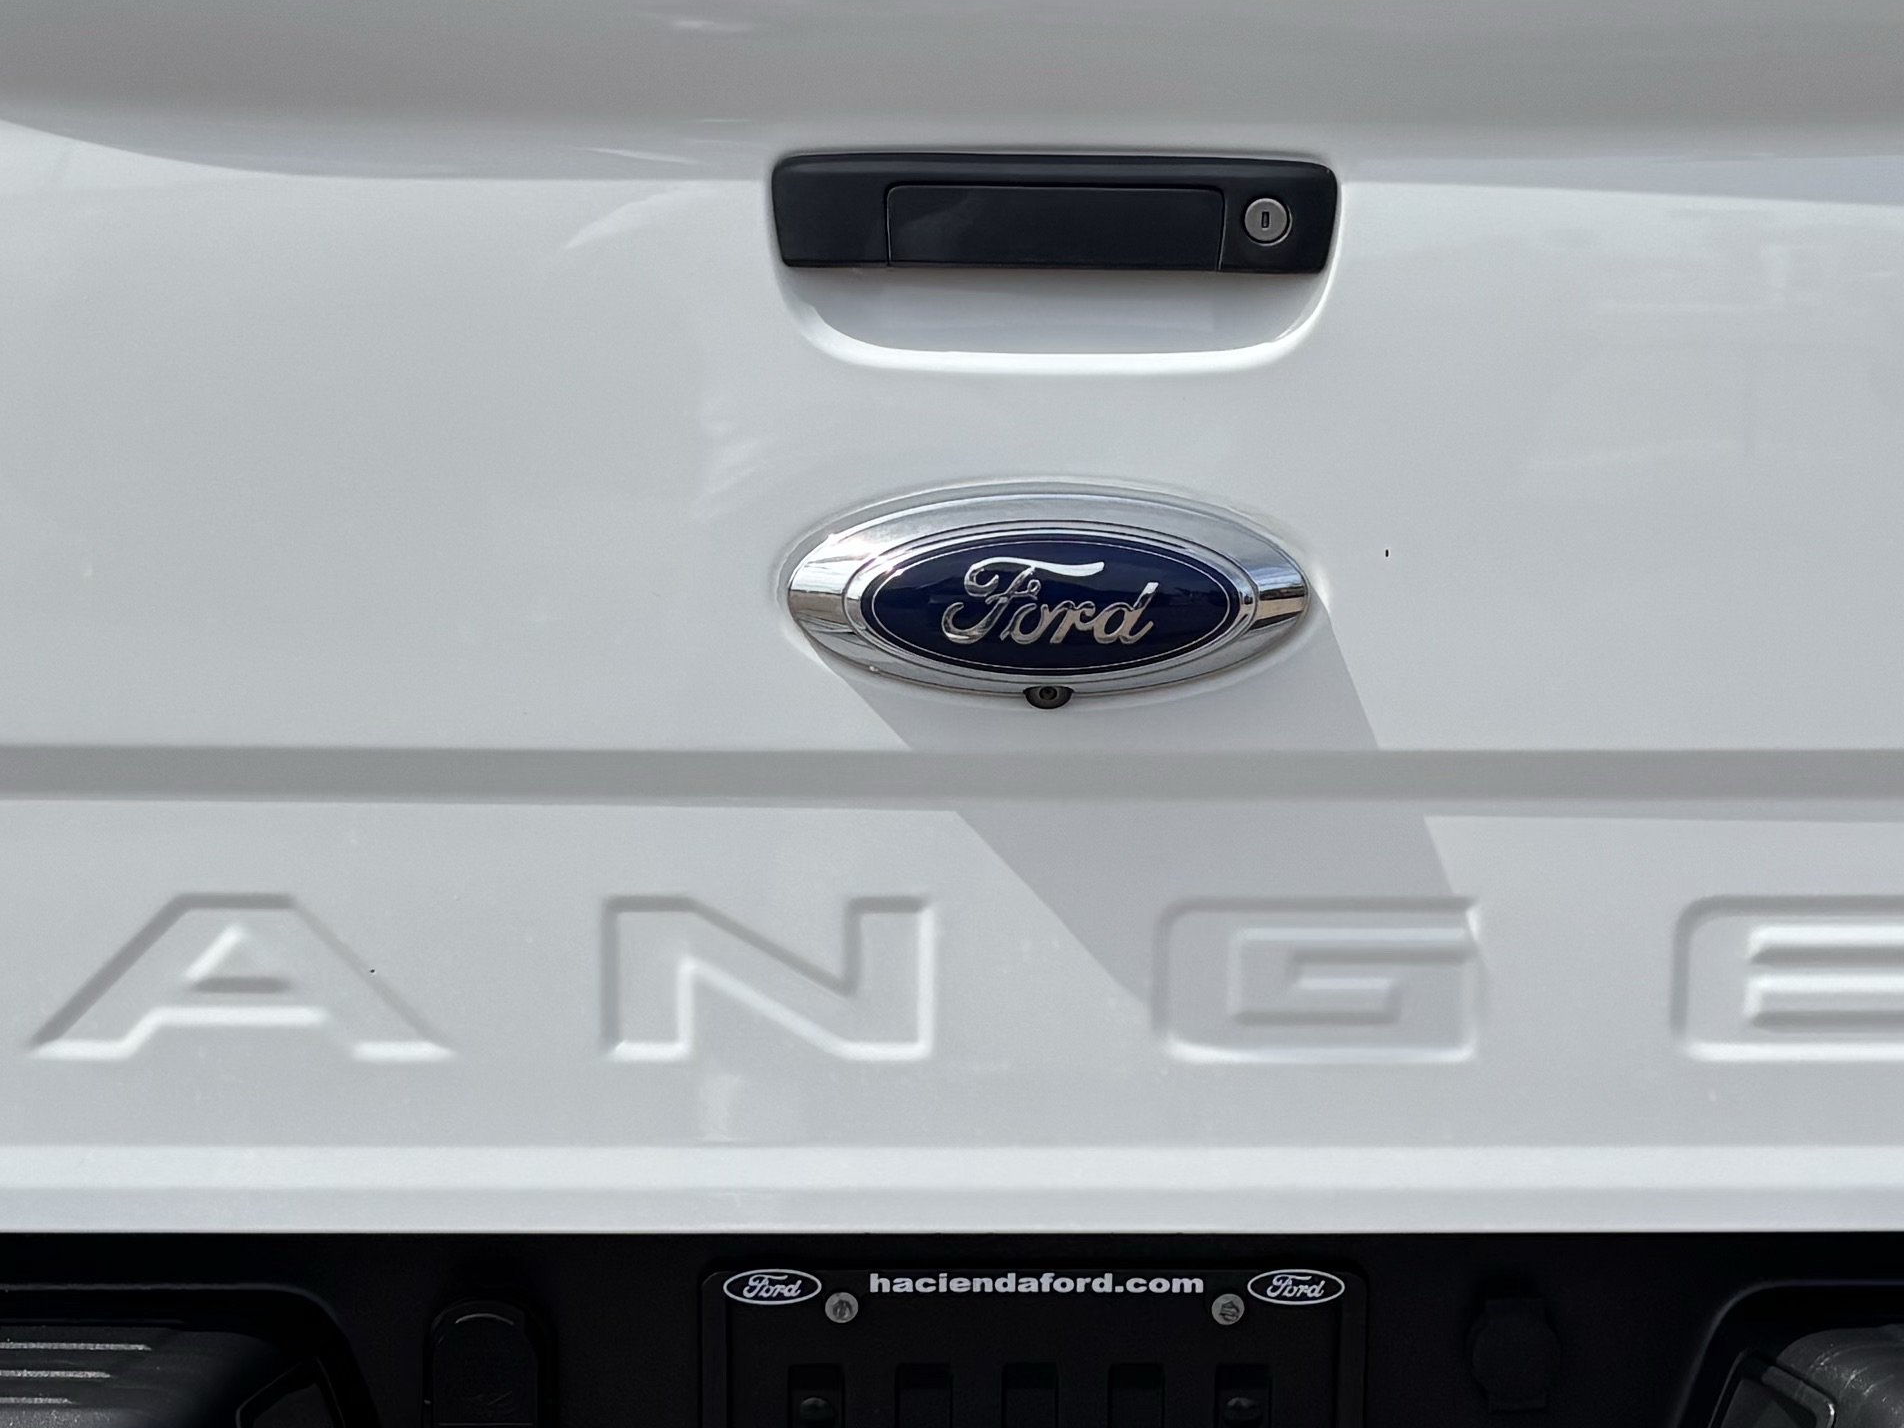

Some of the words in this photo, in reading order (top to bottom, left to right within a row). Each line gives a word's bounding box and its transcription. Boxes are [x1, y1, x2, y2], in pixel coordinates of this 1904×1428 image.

[942, 557, 1159, 644] Ford
[742, 1274, 802, 1299] Ford
[870, 1273, 1203, 1293] haciendaford.com
[1266, 1274, 1326, 1299] Ford
